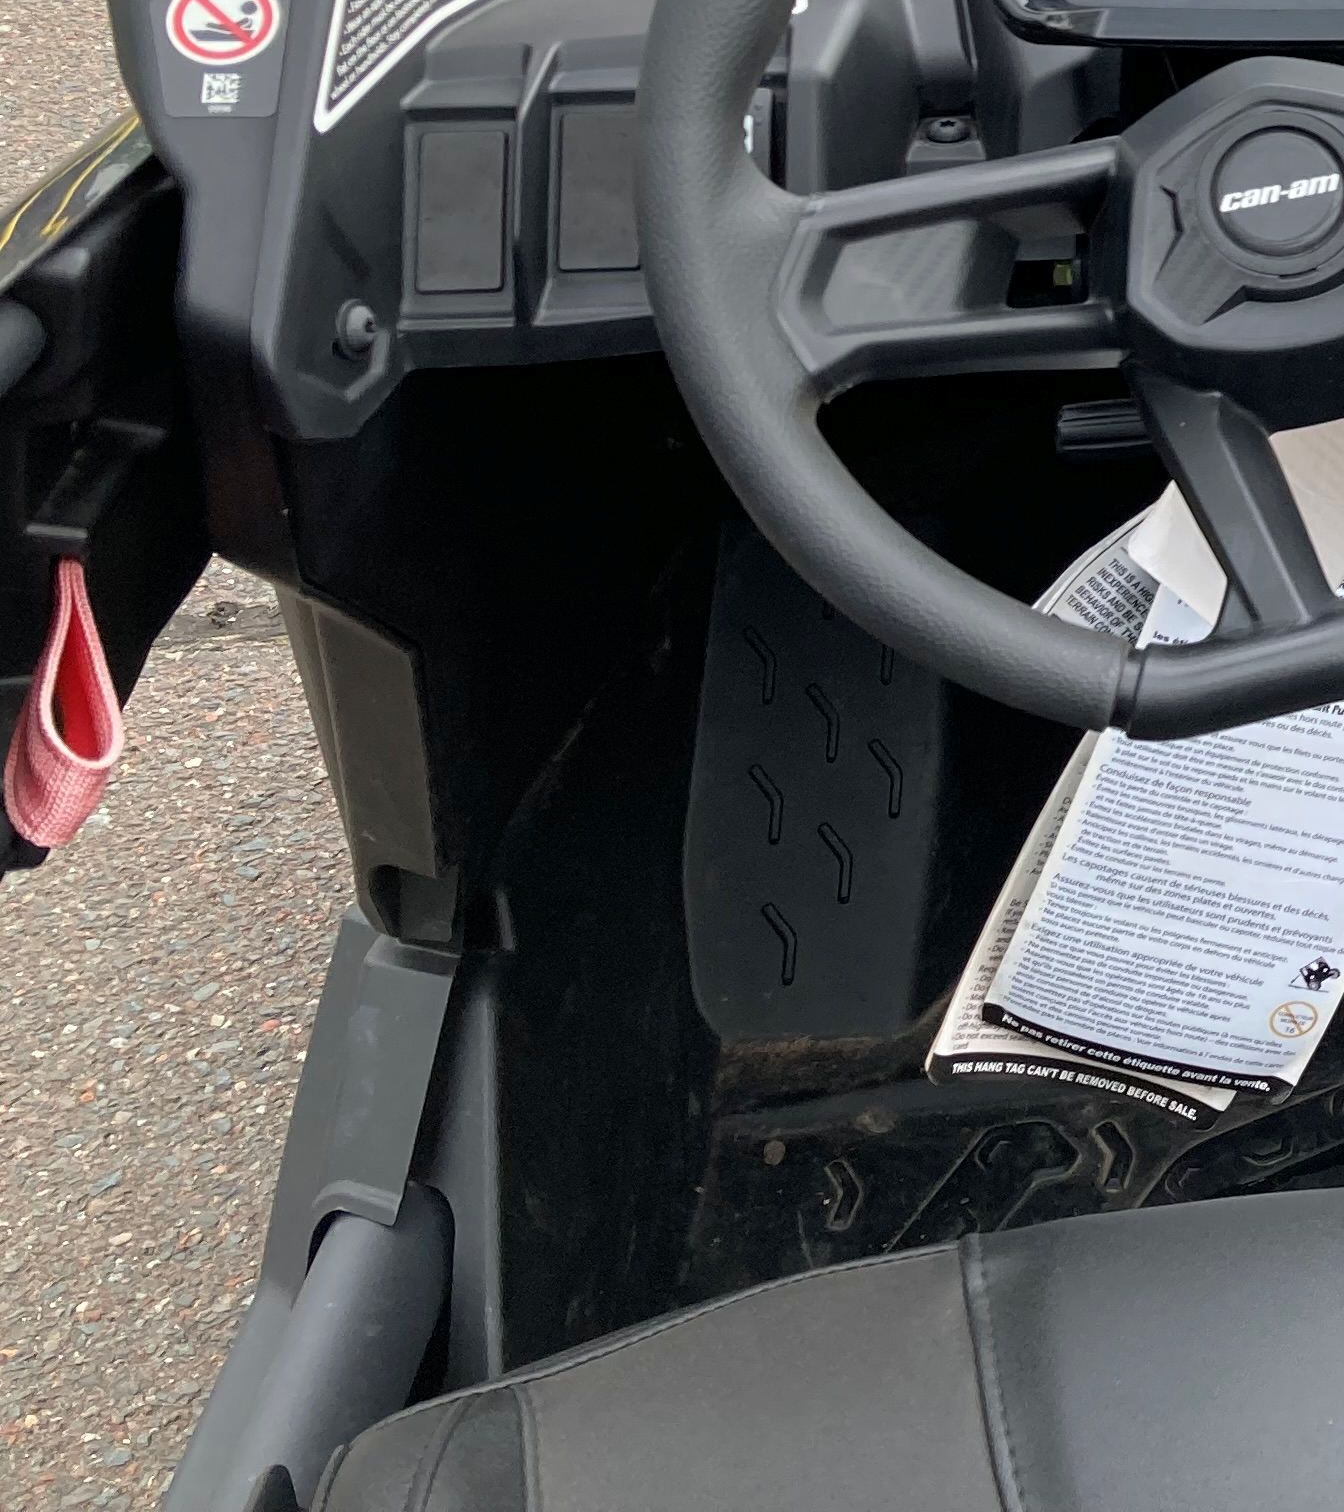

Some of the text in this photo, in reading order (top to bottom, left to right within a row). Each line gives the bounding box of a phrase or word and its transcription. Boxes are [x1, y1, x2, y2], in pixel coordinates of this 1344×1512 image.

[1219, 172, 1341, 213] can-am
[1108, 558, 1128, 577] THIS
[1123, 573, 1136, 584] IS
[1130, 581, 1141, 590] A
[1002, 1013, 1270, 1091] Ne pas retirer cette étiquette avant la vente.
[952, 1061, 1197, 1121] THIS HANG TAG CAN'T BE REMOVED BEFORE SALE.
